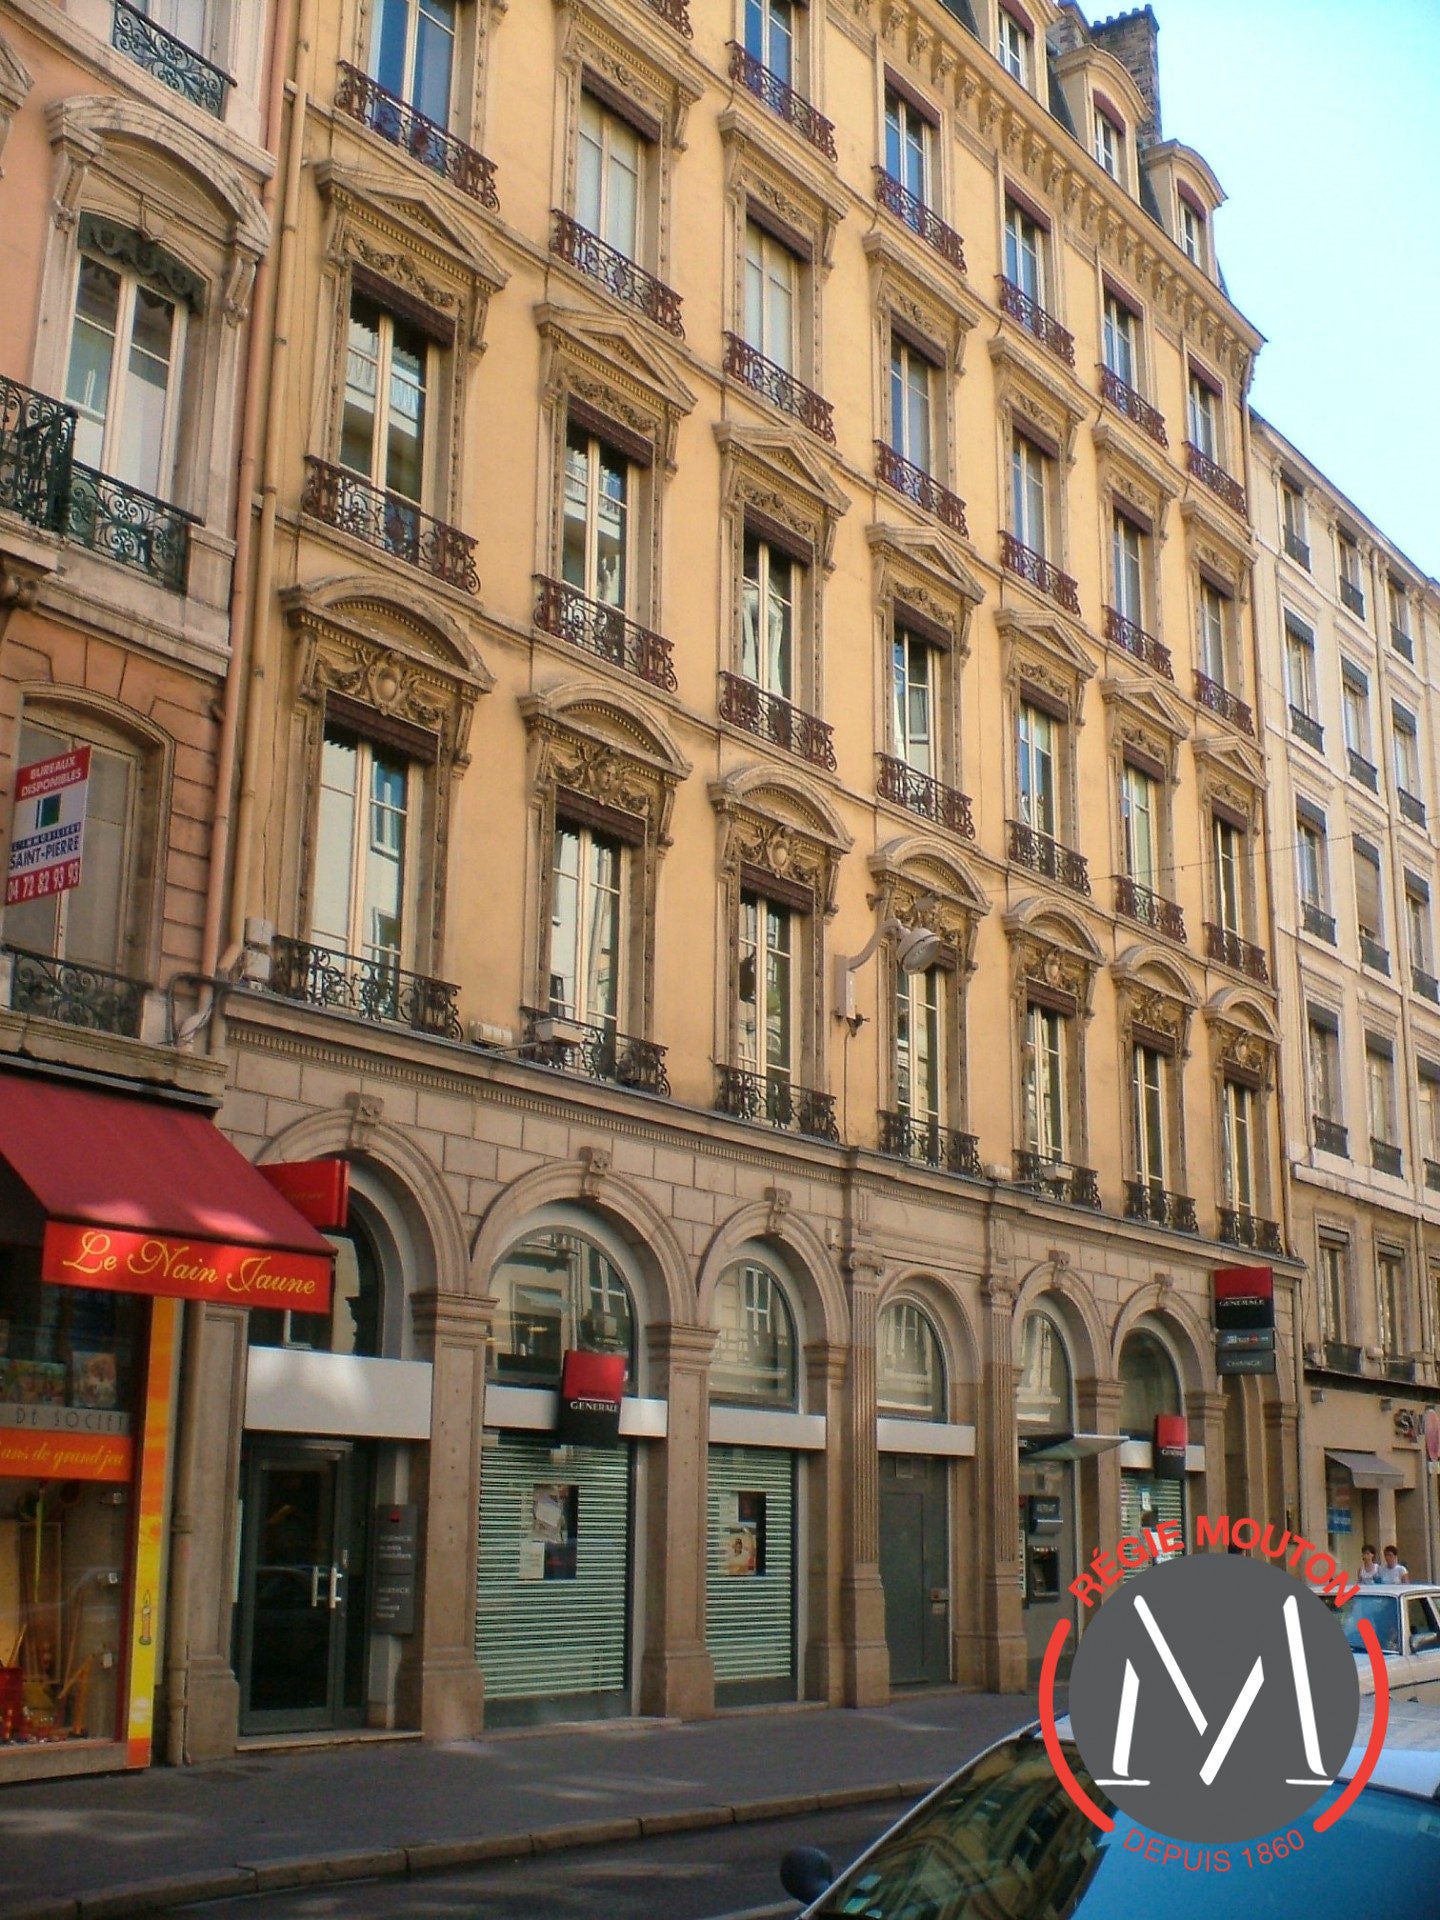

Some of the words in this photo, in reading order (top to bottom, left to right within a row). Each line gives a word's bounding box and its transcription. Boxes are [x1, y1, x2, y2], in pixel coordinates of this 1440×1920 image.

[21, 768, 82, 797] DISPONIBLES
[30, 756, 76, 779] BUREAUX
[10, 835, 80, 870] SAINT-PIERRE
[8, 879, 19, 902] 04
[23, 874, 35, 898] 72
[38, 870, 50, 894] 82
[63, 1231, 118, 1273] Le
[126, 1240, 219, 1284] Nain
[226, 1256, 316, 1294] Jaune
